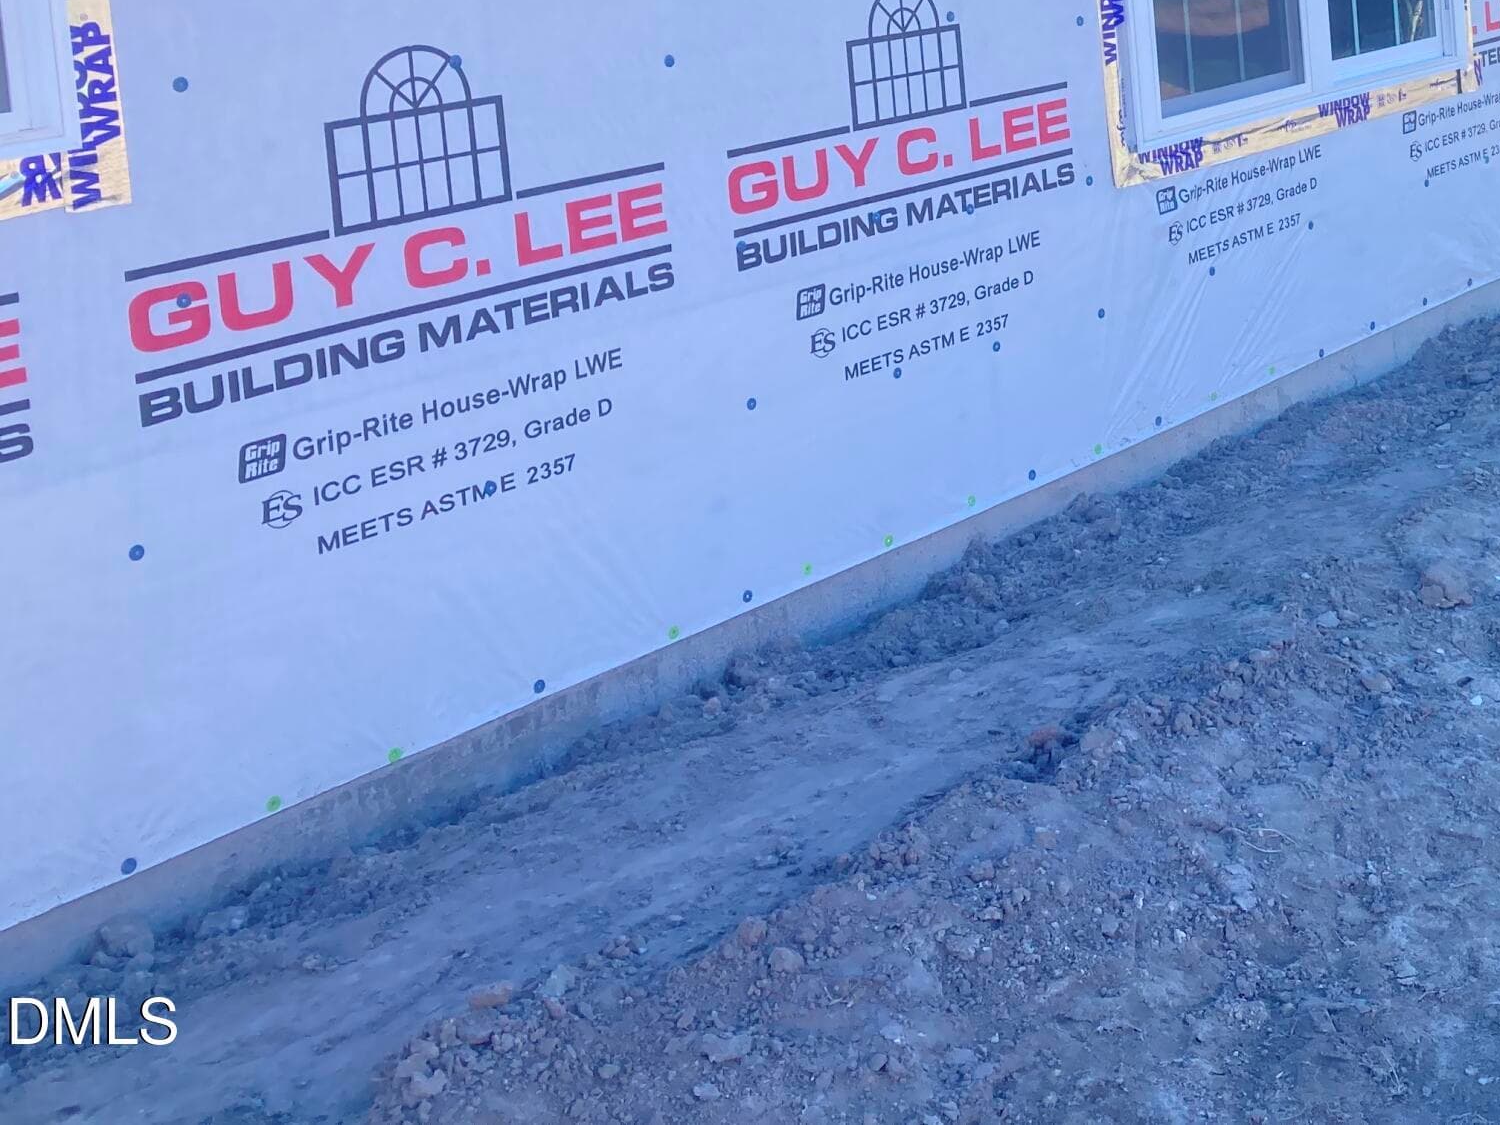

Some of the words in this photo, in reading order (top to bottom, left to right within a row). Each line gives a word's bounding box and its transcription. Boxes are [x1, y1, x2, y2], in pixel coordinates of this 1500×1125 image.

[81, 21, 121, 146] WRAP
[1318, 92, 1370, 118] WINDOW
[1335, 106, 1371, 128] WRAP
[1418, 107, 1455, 127] Grip-Rite
[1425, 138, 1440, 153] ICC
[1442, 131, 1460, 146] ESR
[727, 137, 879, 215] GUY
[897, 127, 953, 176] C.
[968, 98, 1071, 162] LEE
[1138, 136, 1203, 165] WINDOW
[1160, 152, 1204, 176] WRAP
[1178, 177, 1228, 204] Grip-Rite
[1231, 157, 1296, 186] House-Wrap
[1298, 144, 1322, 164] LWE
[1426, 159, 1457, 179] MEETS
[1458, 151, 1481, 167] ASTM
[736, 206, 898, 272] BUILDING
[905, 162, 1075, 226] MATERIALS
[1187, 214, 1207, 233] ICC
[1210, 205, 1234, 225] ESR
[1246, 193, 1274, 213] 3729,
[1276, 182, 1308, 202] Grade
[1309, 177, 1318, 190] D
[126, 242, 376, 353] GUY
[402, 226, 492, 289] C.
[513, 182, 669, 267] LEE
[829, 266, 904, 306] Grip-Rite
[909, 241, 1003, 284] House-Wrap
[1007, 230, 1041, 257] LWE
[1188, 239, 1230, 266] MEETS
[1231, 225, 1264, 249] ASTM
[1267, 222, 1275, 235] E
[1278, 213, 1302, 232] 2357
[841, 319, 872, 342] ICC
[877, 306, 911, 332] ESR
[915, 303, 927, 319] #
[929, 292, 970, 314] 3729,
[974, 276, 1019, 301] Grade
[1022, 269, 1034, 286] D
[138, 328, 406, 429] BUILDING
[417, 261, 675, 353] MATERIALS
[844, 348, 904, 380] MEETS
[908, 331, 956, 360] ASTM
[959, 326, 971, 342] E
[976, 313, 1009, 338] 2357
[292, 409, 414, 462] Grip-Rite
[420, 363, 568, 424] House-Wrap
[573, 347, 624, 379] LWE
[243, 437, 281, 463] Grip
[243, 456, 281, 482] Rite
[312, 474, 362, 506] ICC
[370, 454, 426, 487] ESR
[431, 447, 448, 469] #
[453, 428, 518, 462] 3729,
[523, 405, 592, 441] Grade
[597, 397, 613, 417] D
[316, 508, 416, 556] MEETS
[420, 480, 494, 520] ASTM
[500, 472, 517, 494] E
[526, 453, 577, 486] 2357
